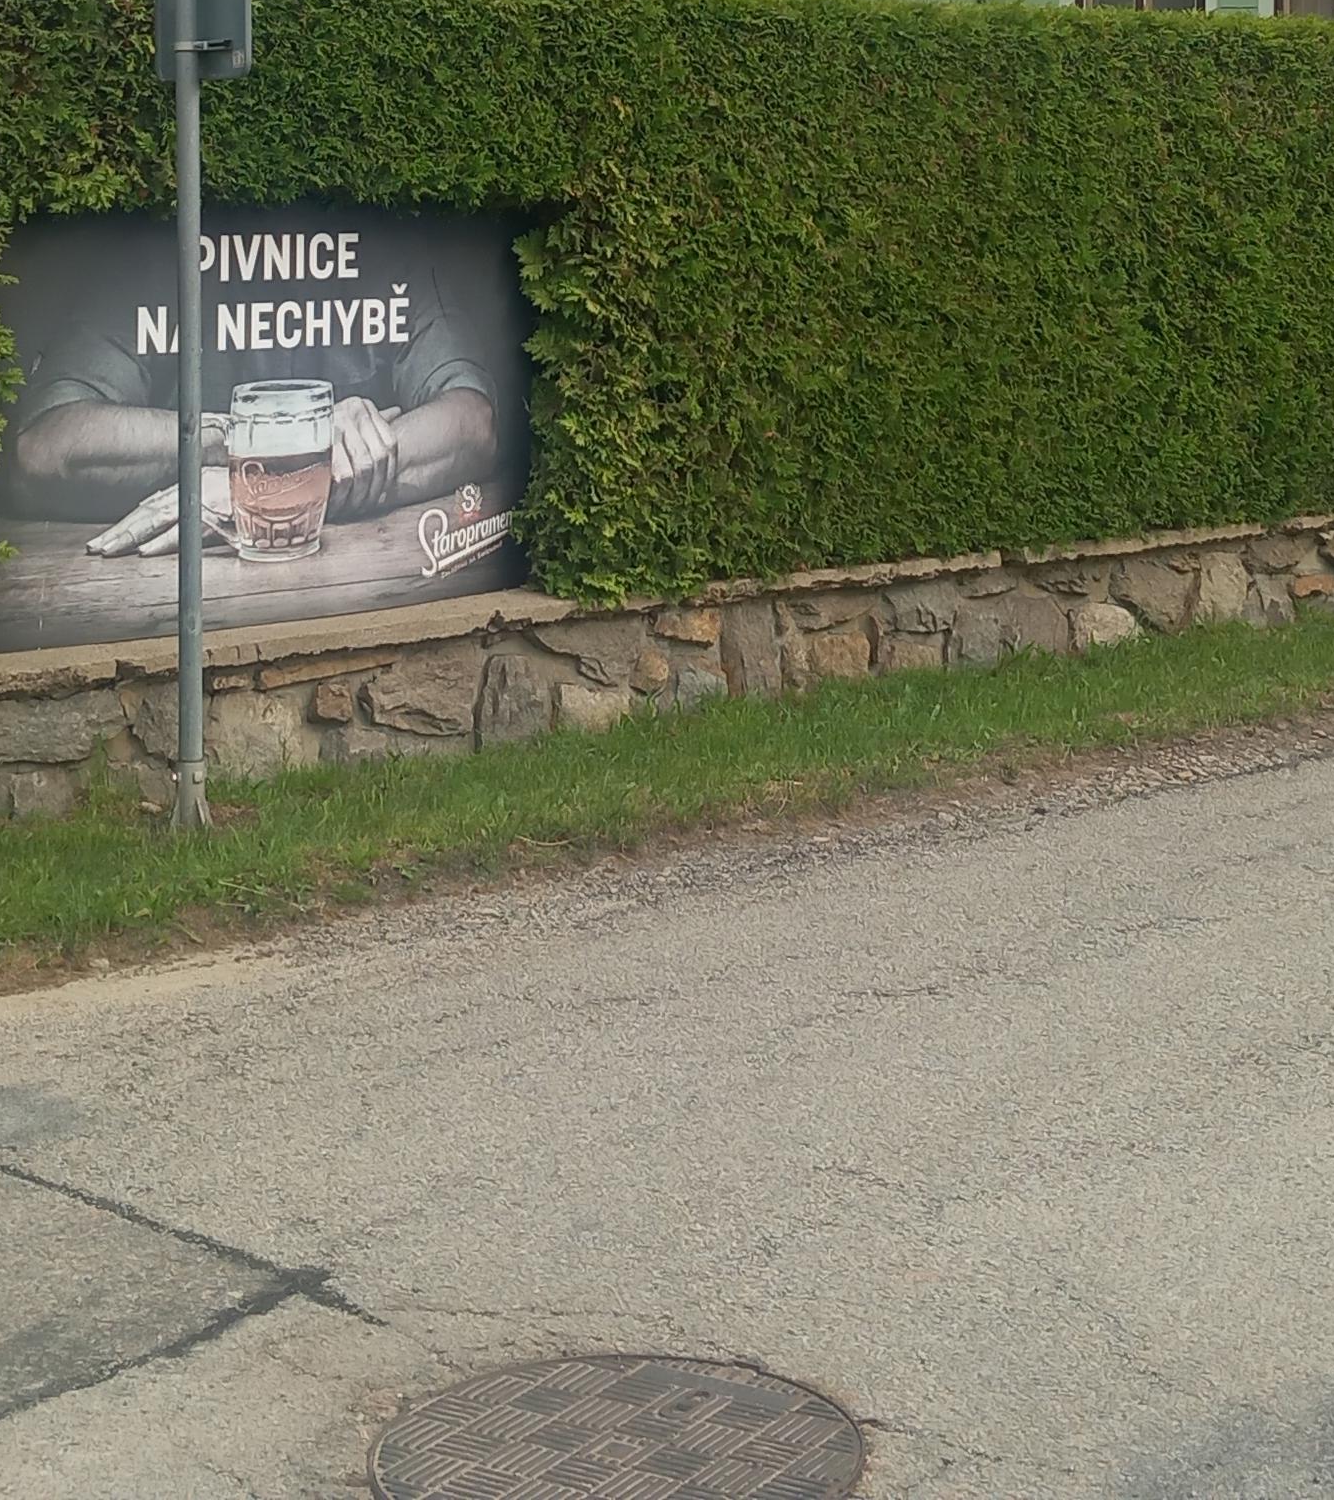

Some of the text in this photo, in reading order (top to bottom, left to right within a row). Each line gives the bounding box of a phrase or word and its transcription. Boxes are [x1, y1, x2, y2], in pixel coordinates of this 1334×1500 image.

[199, 232, 360, 282] PIVNICE
[136, 283, 410, 355] N NECHYBĚ
[418, 508, 513, 578] Staropramen
